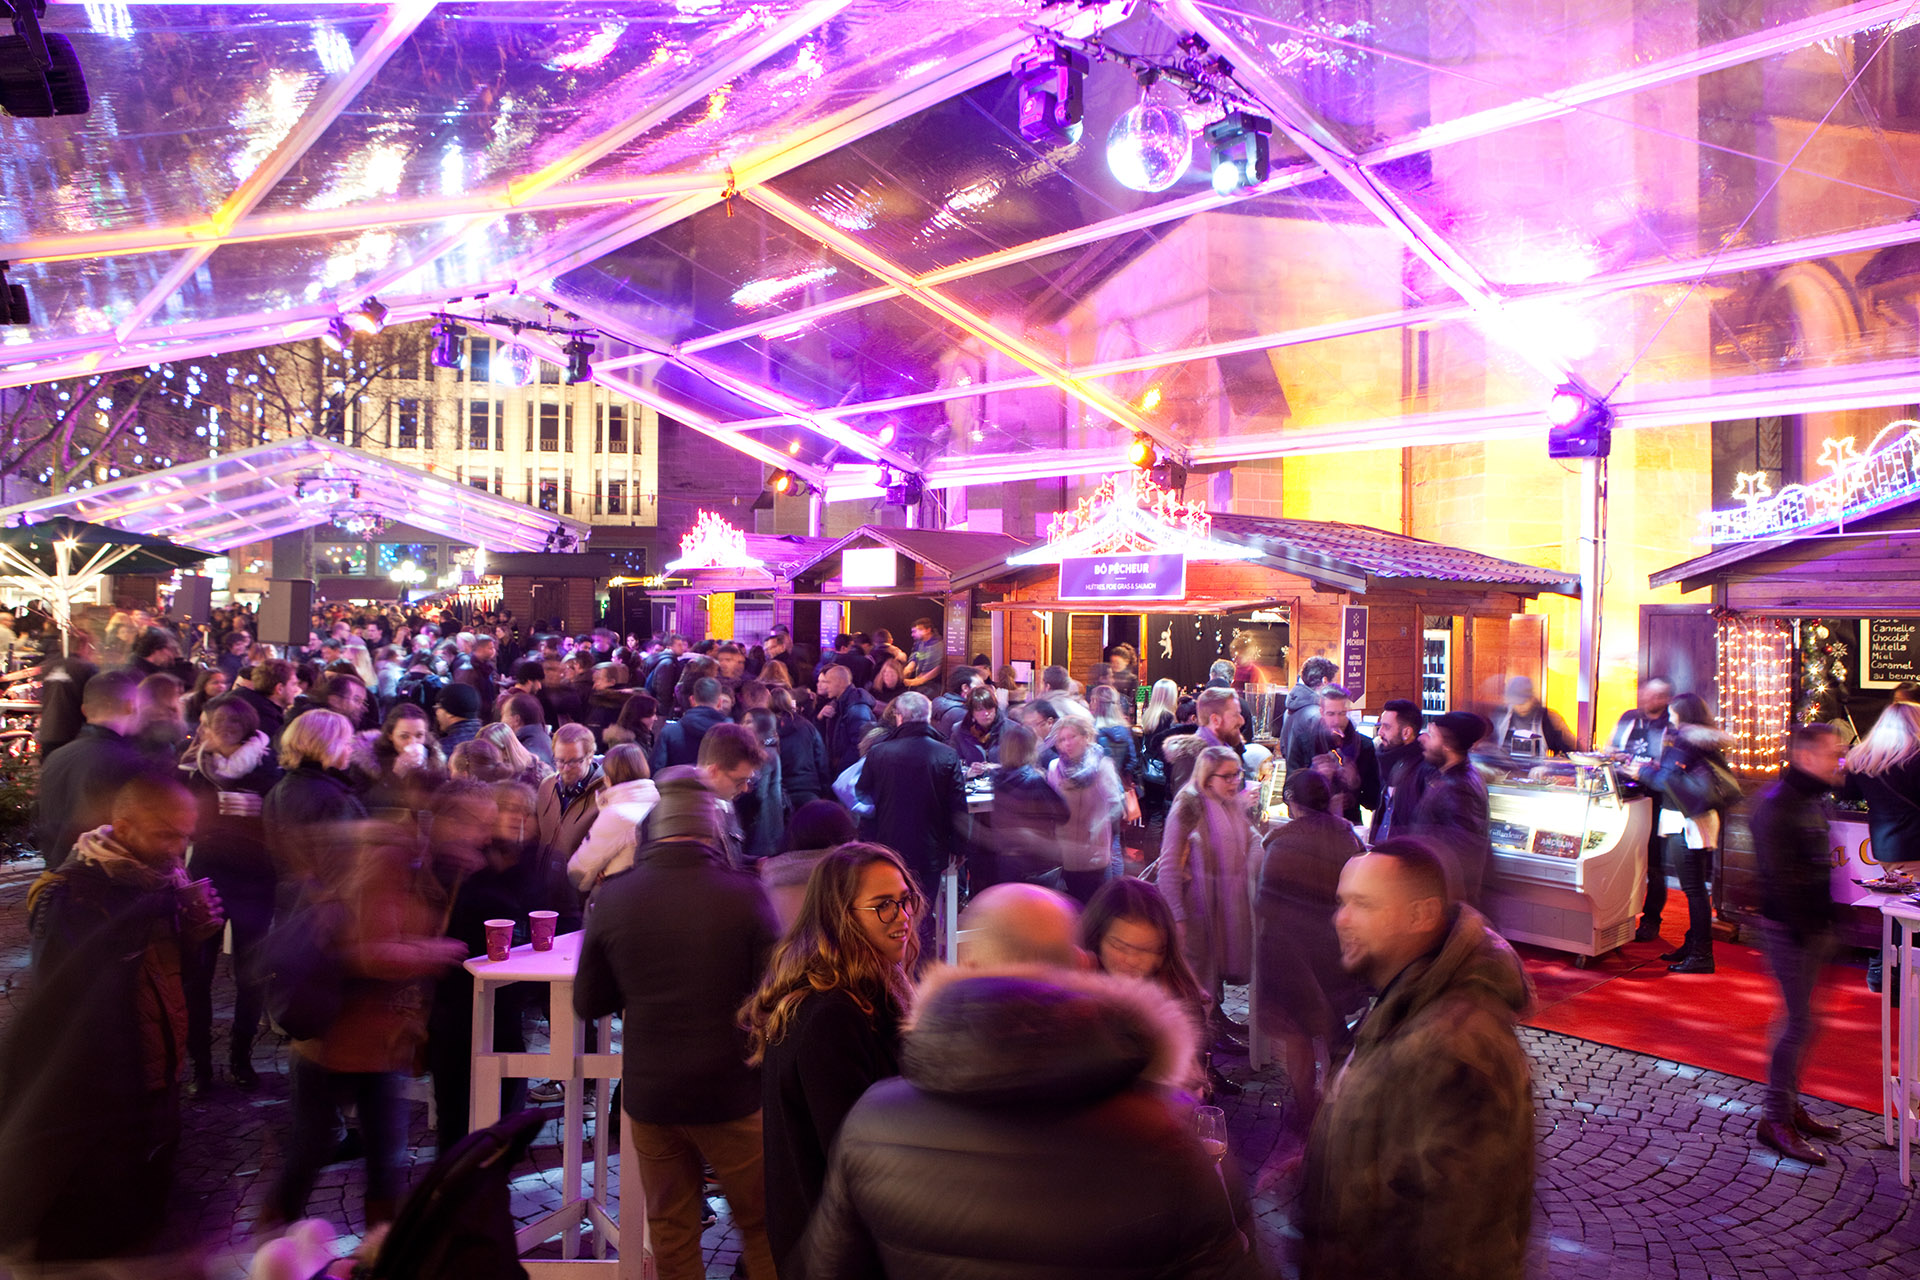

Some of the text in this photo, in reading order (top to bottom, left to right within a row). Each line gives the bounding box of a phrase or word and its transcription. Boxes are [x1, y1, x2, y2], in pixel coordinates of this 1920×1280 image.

[1094, 562, 1149, 575] BÔ PÊCHEUR
[1872, 624, 1916, 633] Cannelle
[1872, 633, 1910, 642] Chocolat
[1872, 642, 1907, 651] Nutella
[1872, 652, 1893, 660] Miel
[1871, 660, 1914, 670] Caramel
[1873, 672, 1920, 680] au beurre
